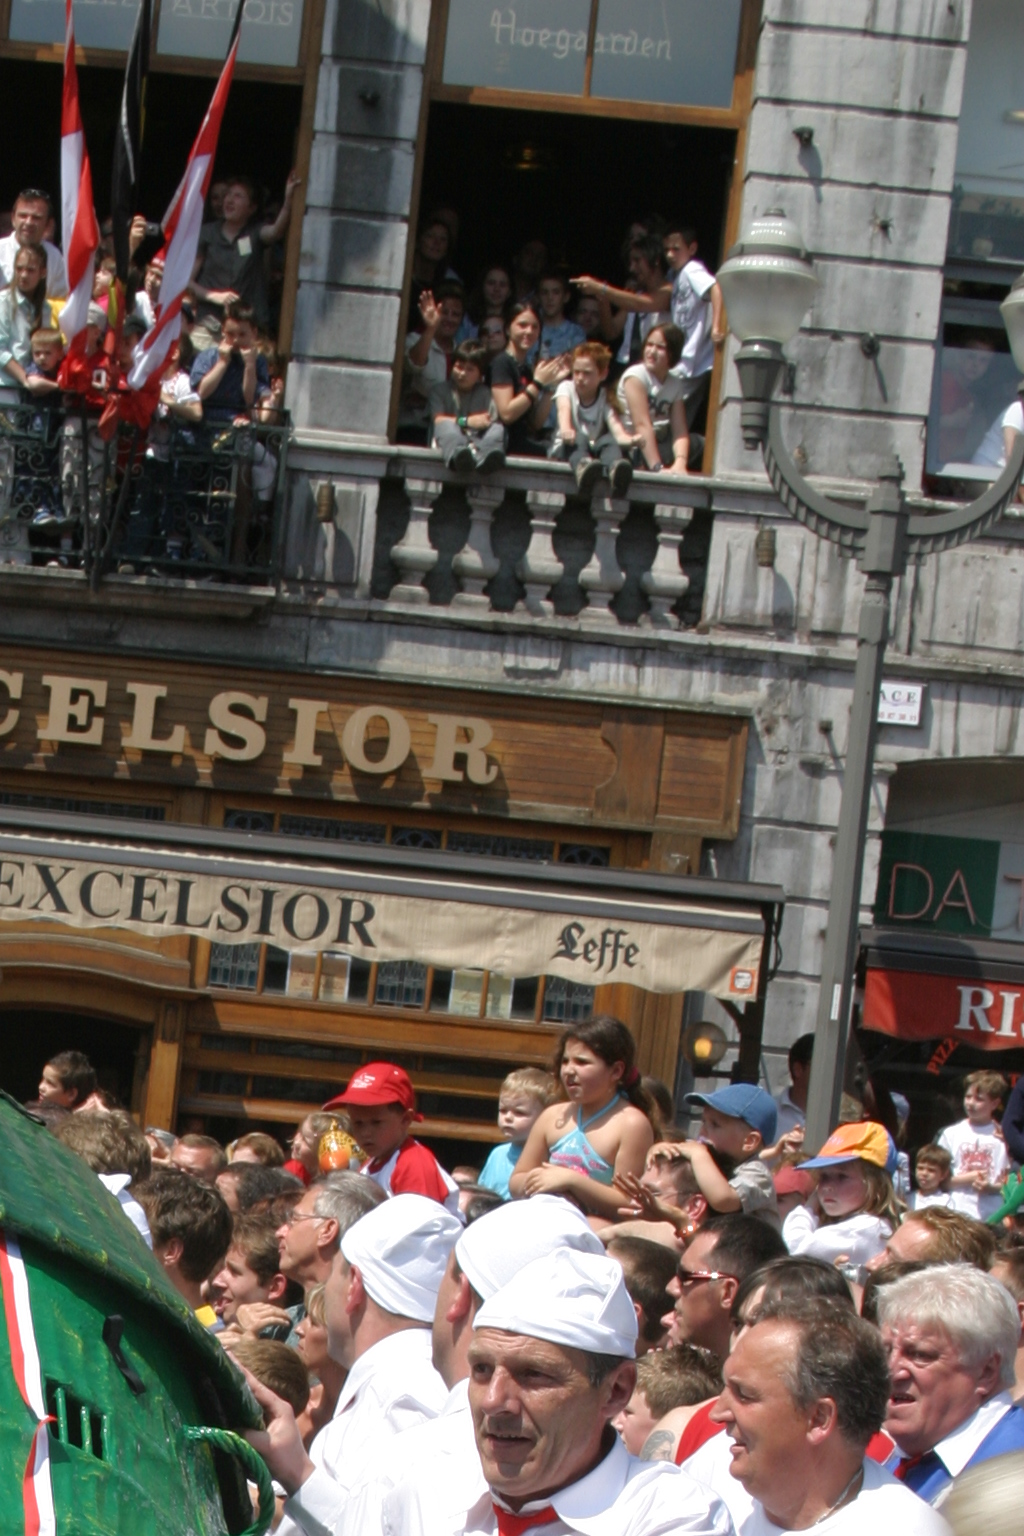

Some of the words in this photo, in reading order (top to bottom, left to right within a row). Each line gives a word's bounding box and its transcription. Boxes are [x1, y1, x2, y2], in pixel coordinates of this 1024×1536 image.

[489, 8, 672, 60] Hoegaarden
[888, 863, 976, 925] DA
[550, 921, 640, 974] Leffe
[954, 985, 1024, 1038] RI
